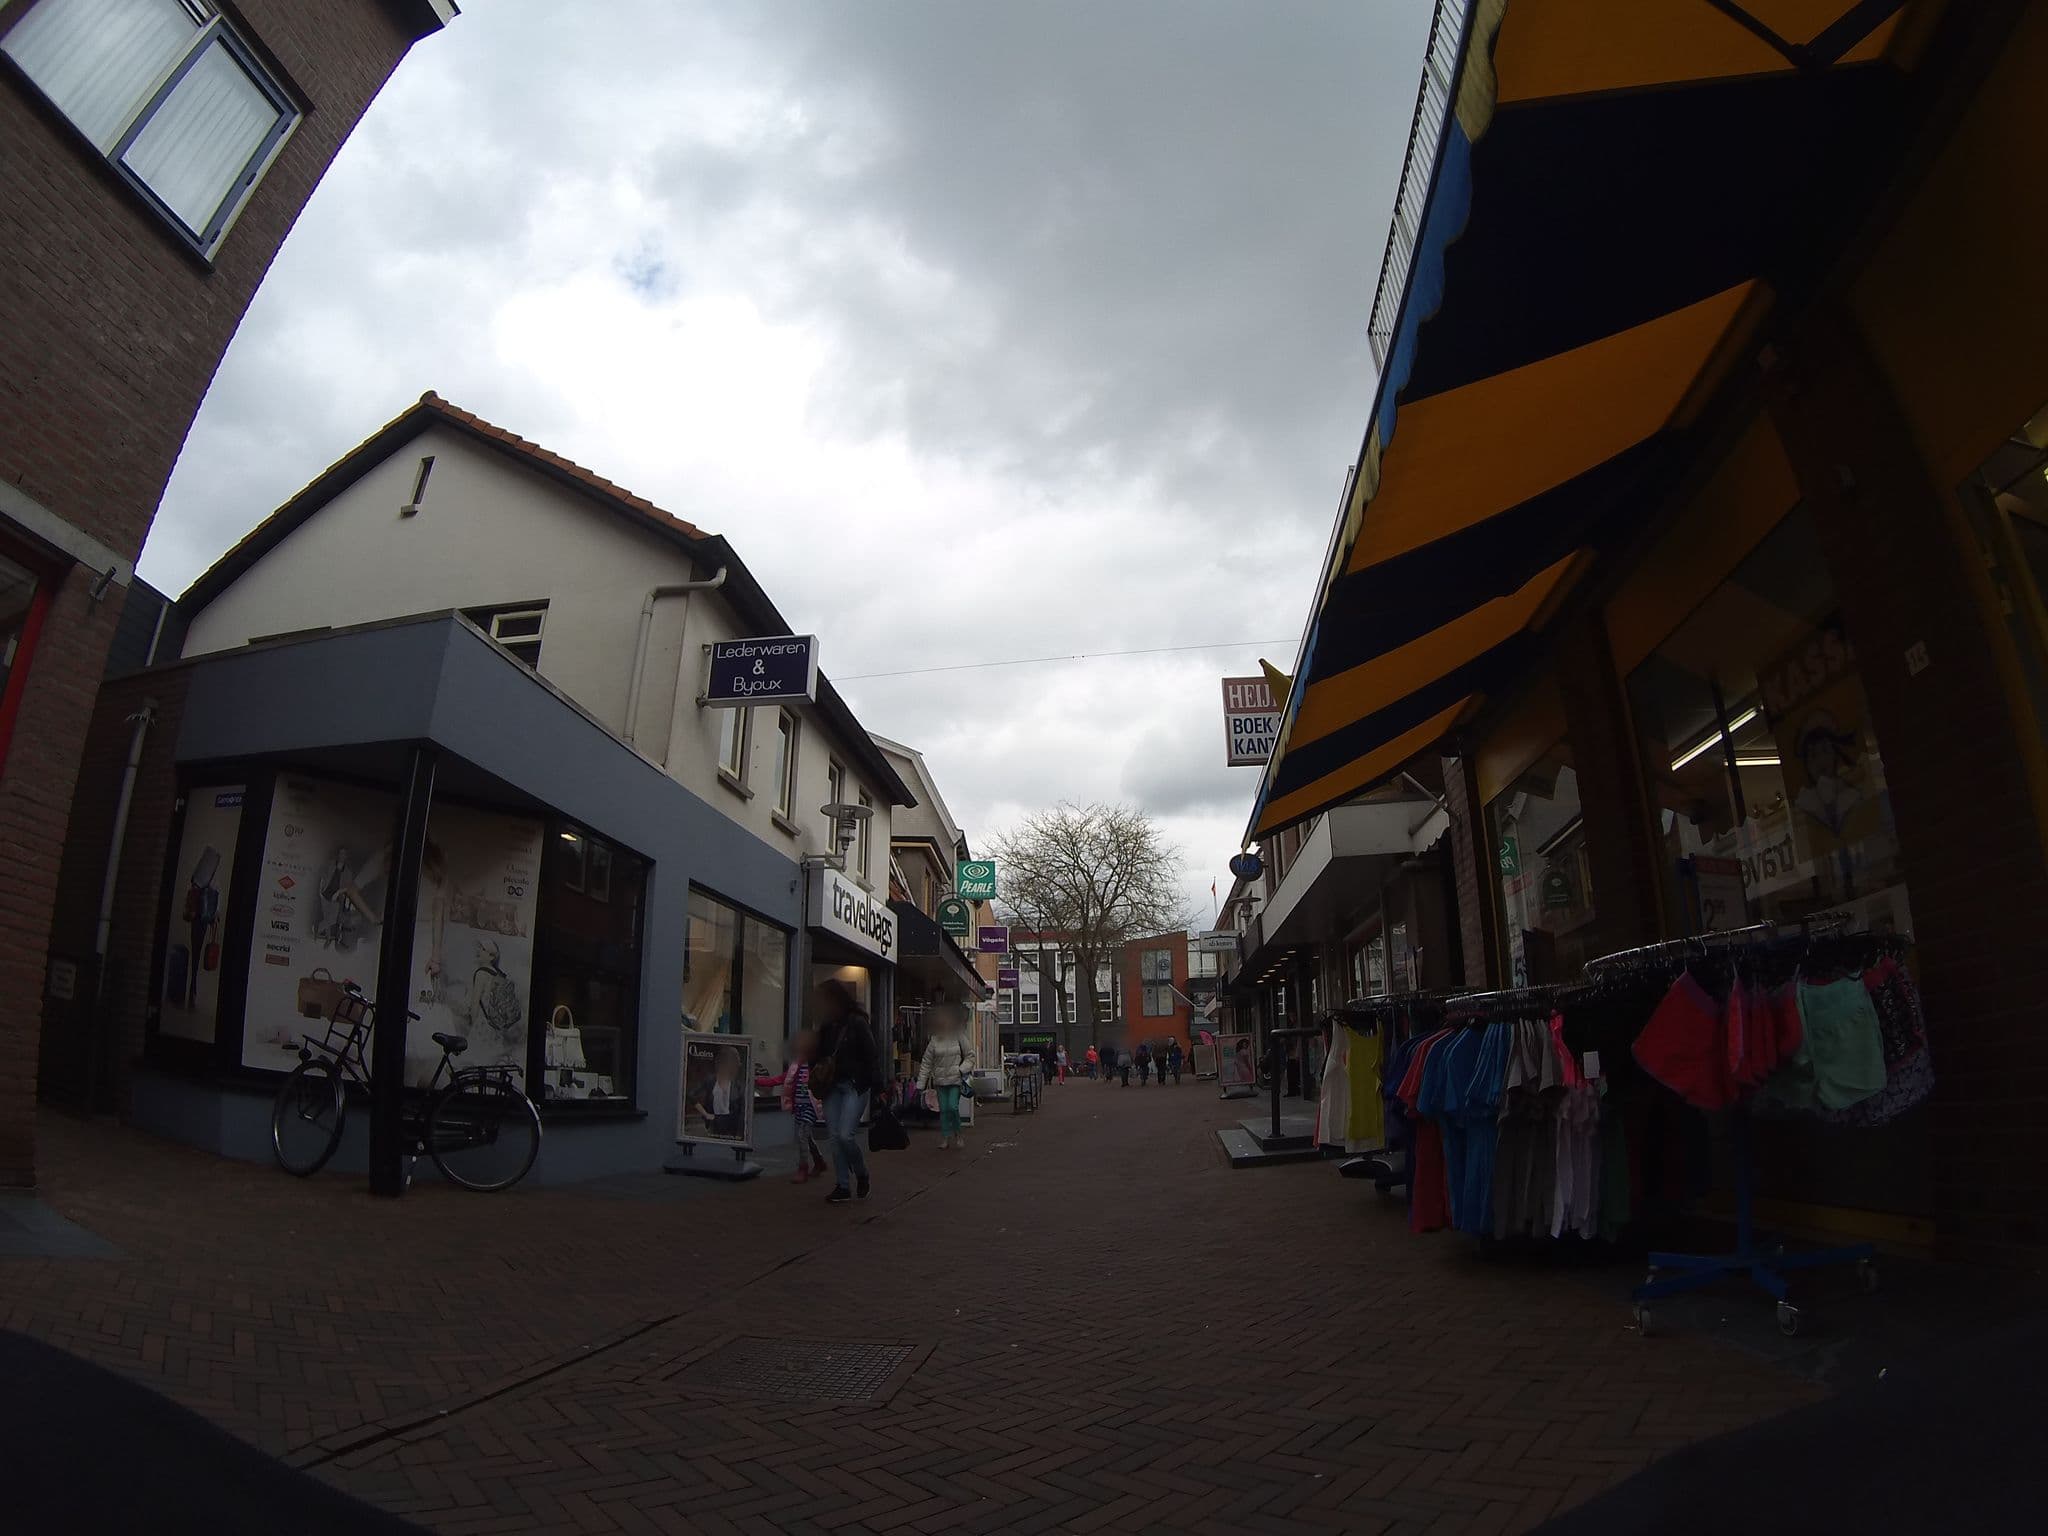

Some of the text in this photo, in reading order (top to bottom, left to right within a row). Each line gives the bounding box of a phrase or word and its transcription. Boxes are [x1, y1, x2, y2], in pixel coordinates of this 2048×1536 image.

[717, 643, 806, 659] Lederwaren
[752, 658, 765, 675] &
[733, 676, 782, 696] Byoux
[1233, 717, 1273, 734] BOEK
[960, 880, 993, 893] PEARLE
[833, 877, 892, 956] travelbags
